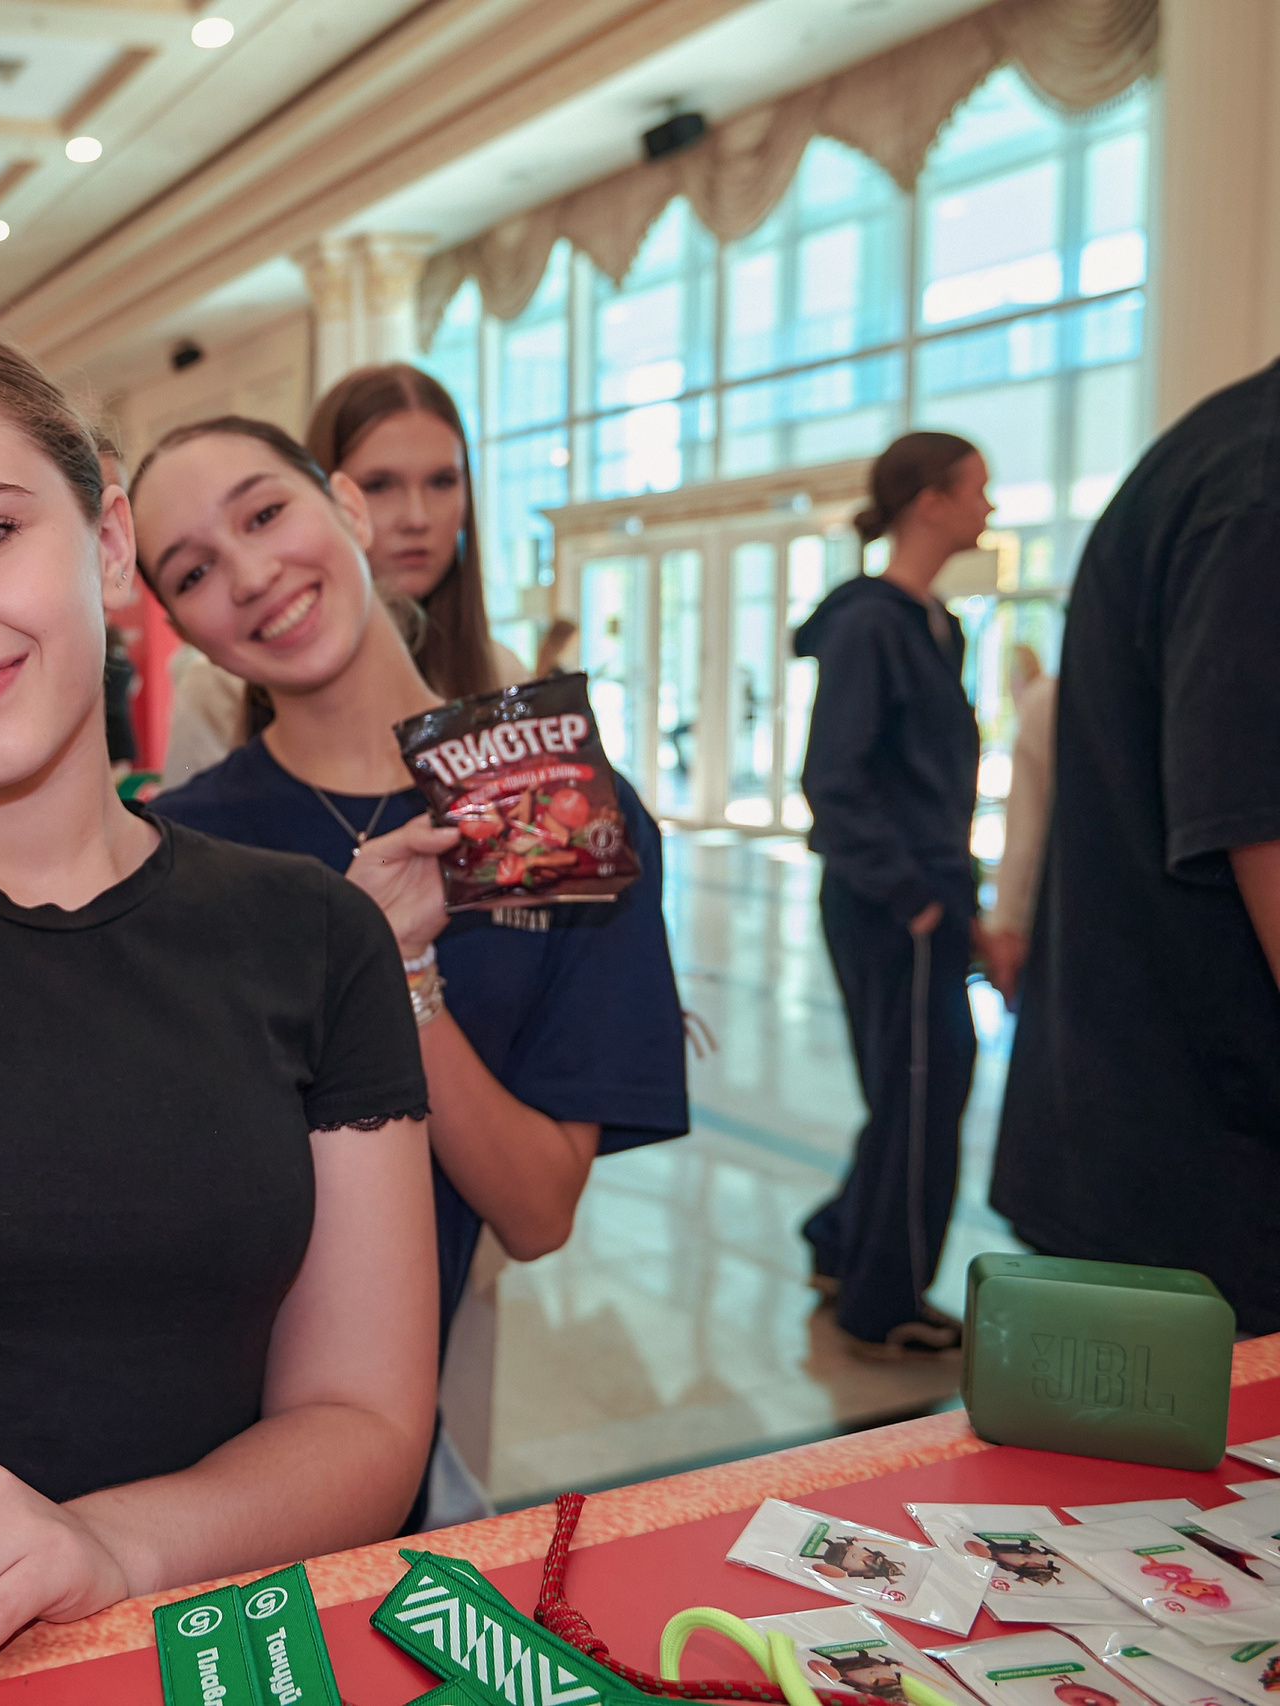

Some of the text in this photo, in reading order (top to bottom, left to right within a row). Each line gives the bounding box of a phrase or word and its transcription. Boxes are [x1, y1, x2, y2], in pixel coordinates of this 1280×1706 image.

[416, 714, 588, 786] ТВИСТЕР
[1031, 1334, 1175, 1417] JBL
[266, 1626, 302, 1706] Танцуй
